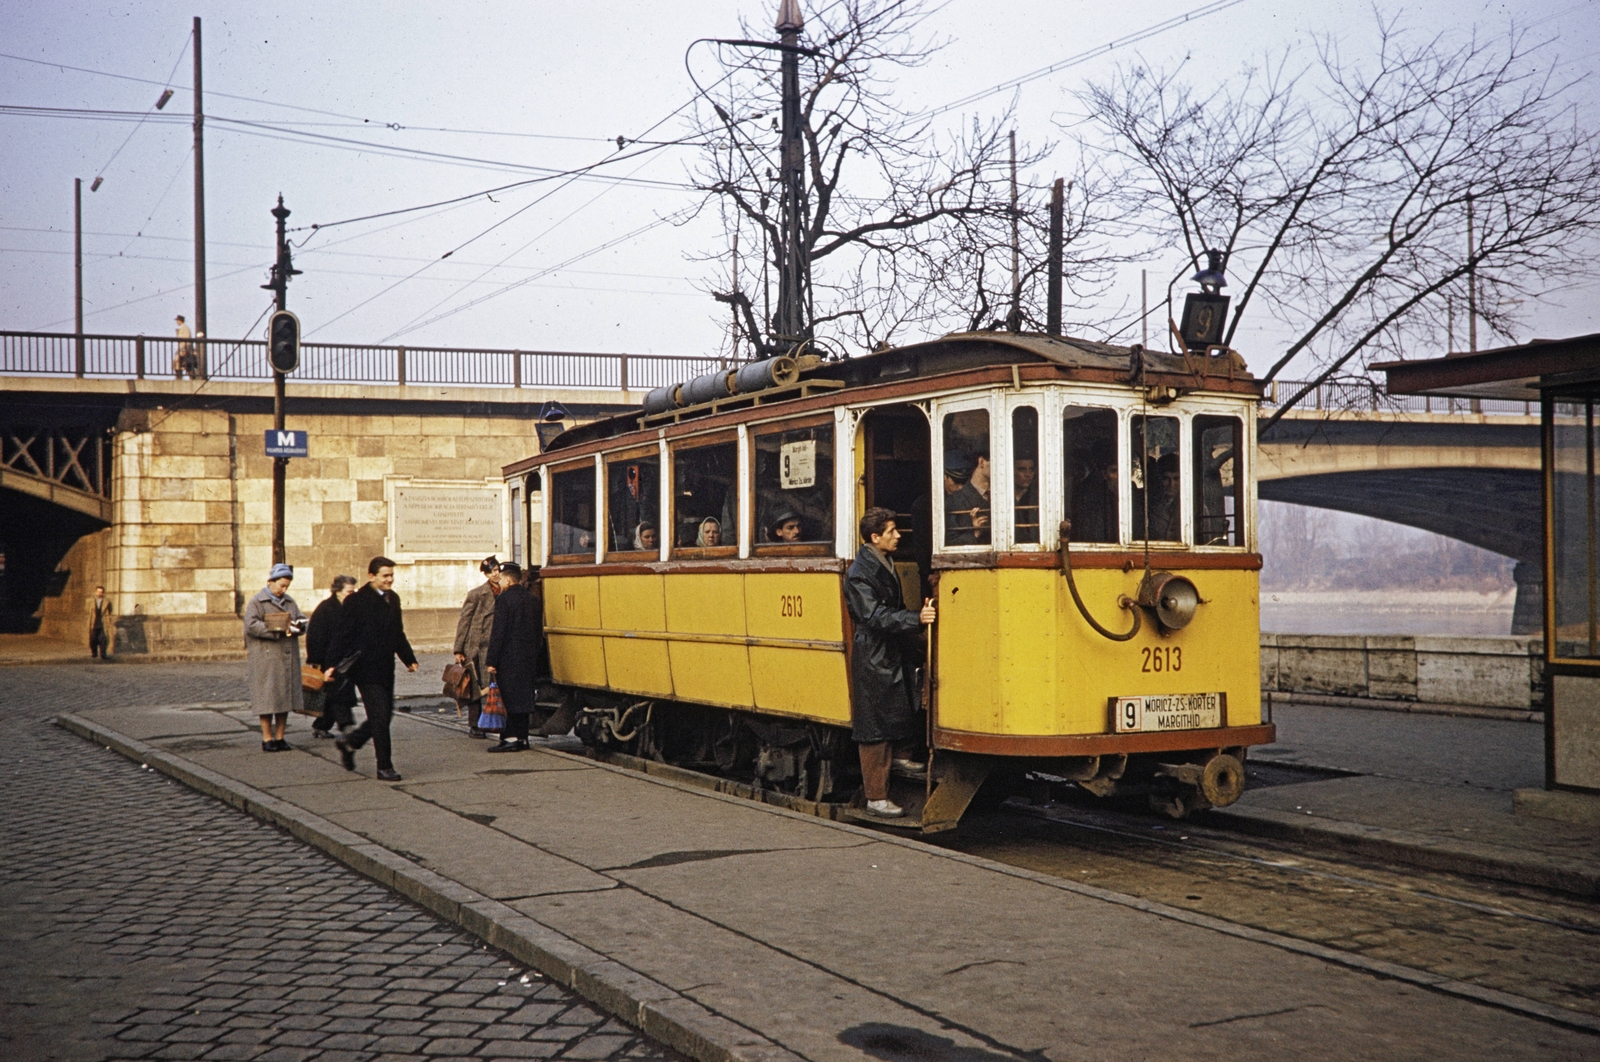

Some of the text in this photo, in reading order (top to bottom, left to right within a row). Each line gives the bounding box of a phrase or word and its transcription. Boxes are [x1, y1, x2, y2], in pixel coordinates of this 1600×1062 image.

[1196, 304, 1213, 339] 9
[277, 431, 295, 447] M
[784, 455, 790, 478] 9
[781, 594, 803, 618] 2613
[1141, 646, 1182, 673] 2613
[1125, 702, 1136, 729] 9
